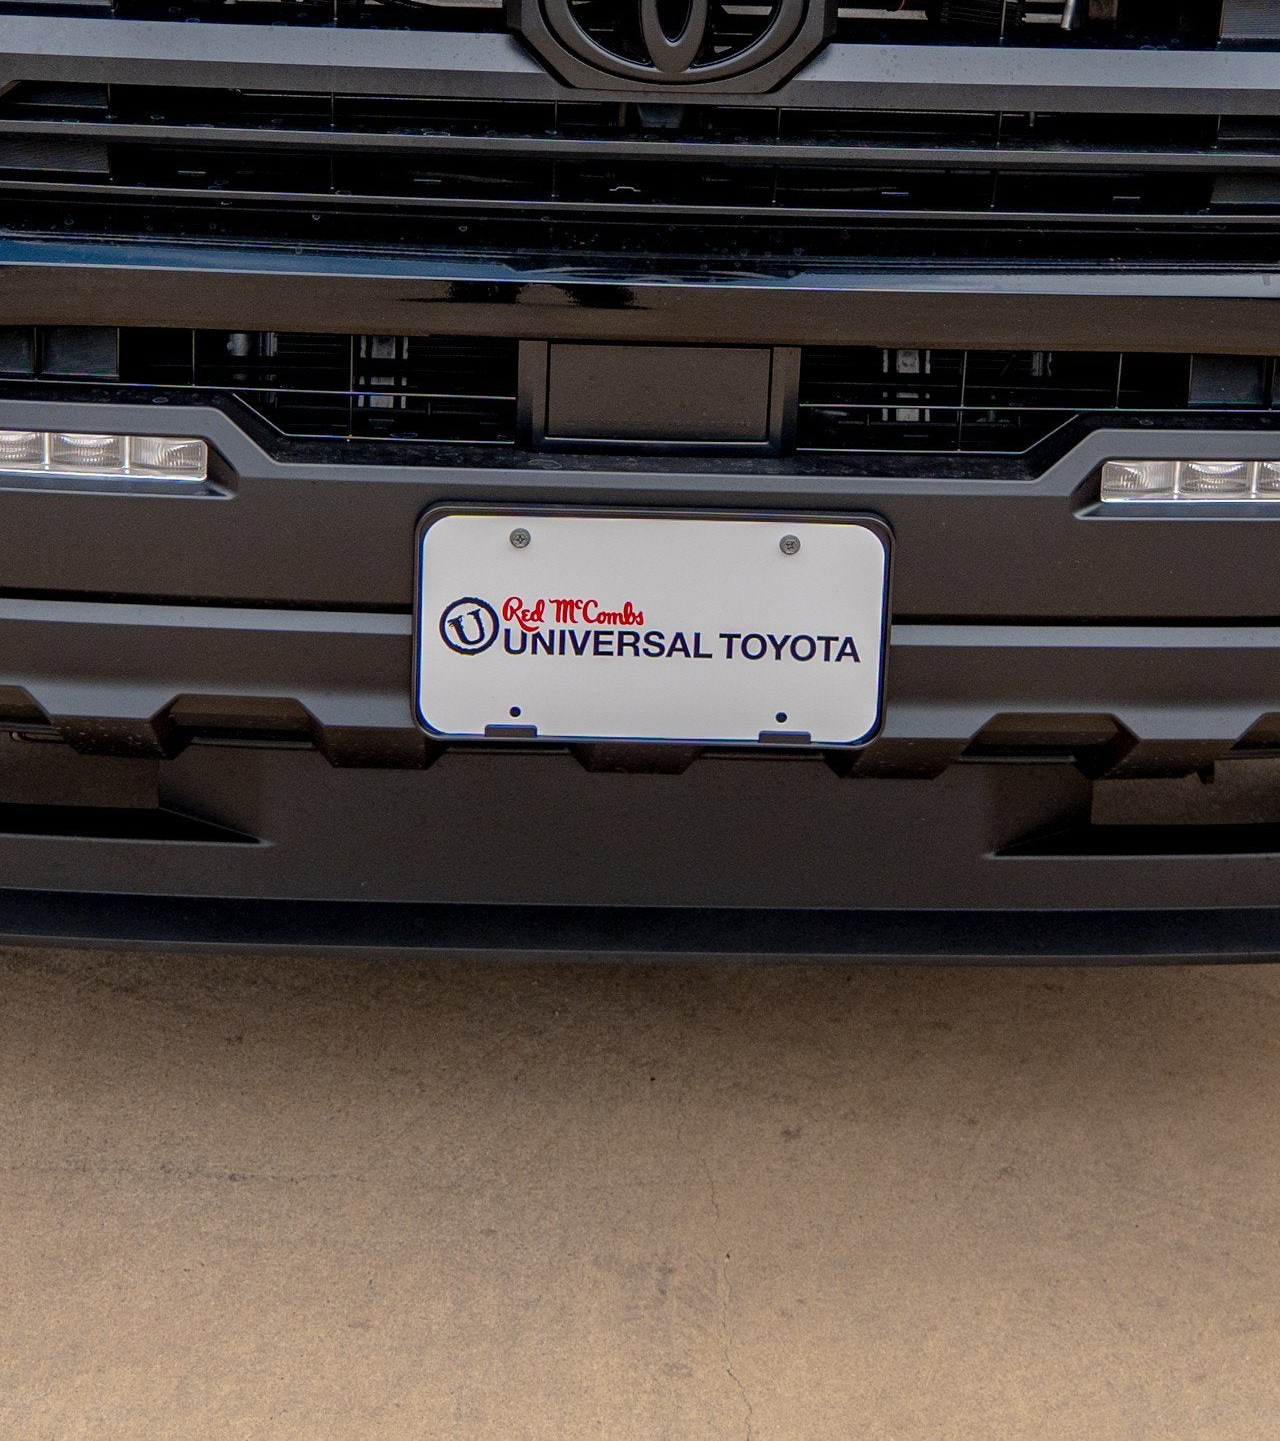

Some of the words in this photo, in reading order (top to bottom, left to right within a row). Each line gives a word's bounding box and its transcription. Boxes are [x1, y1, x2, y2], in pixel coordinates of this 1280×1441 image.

[501, 595, 546, 633] Red
[548, 598, 645, 627] McCombs
[503, 627, 713, 660] UNIVERSAL
[719, 631, 862, 664] TOYOTA
